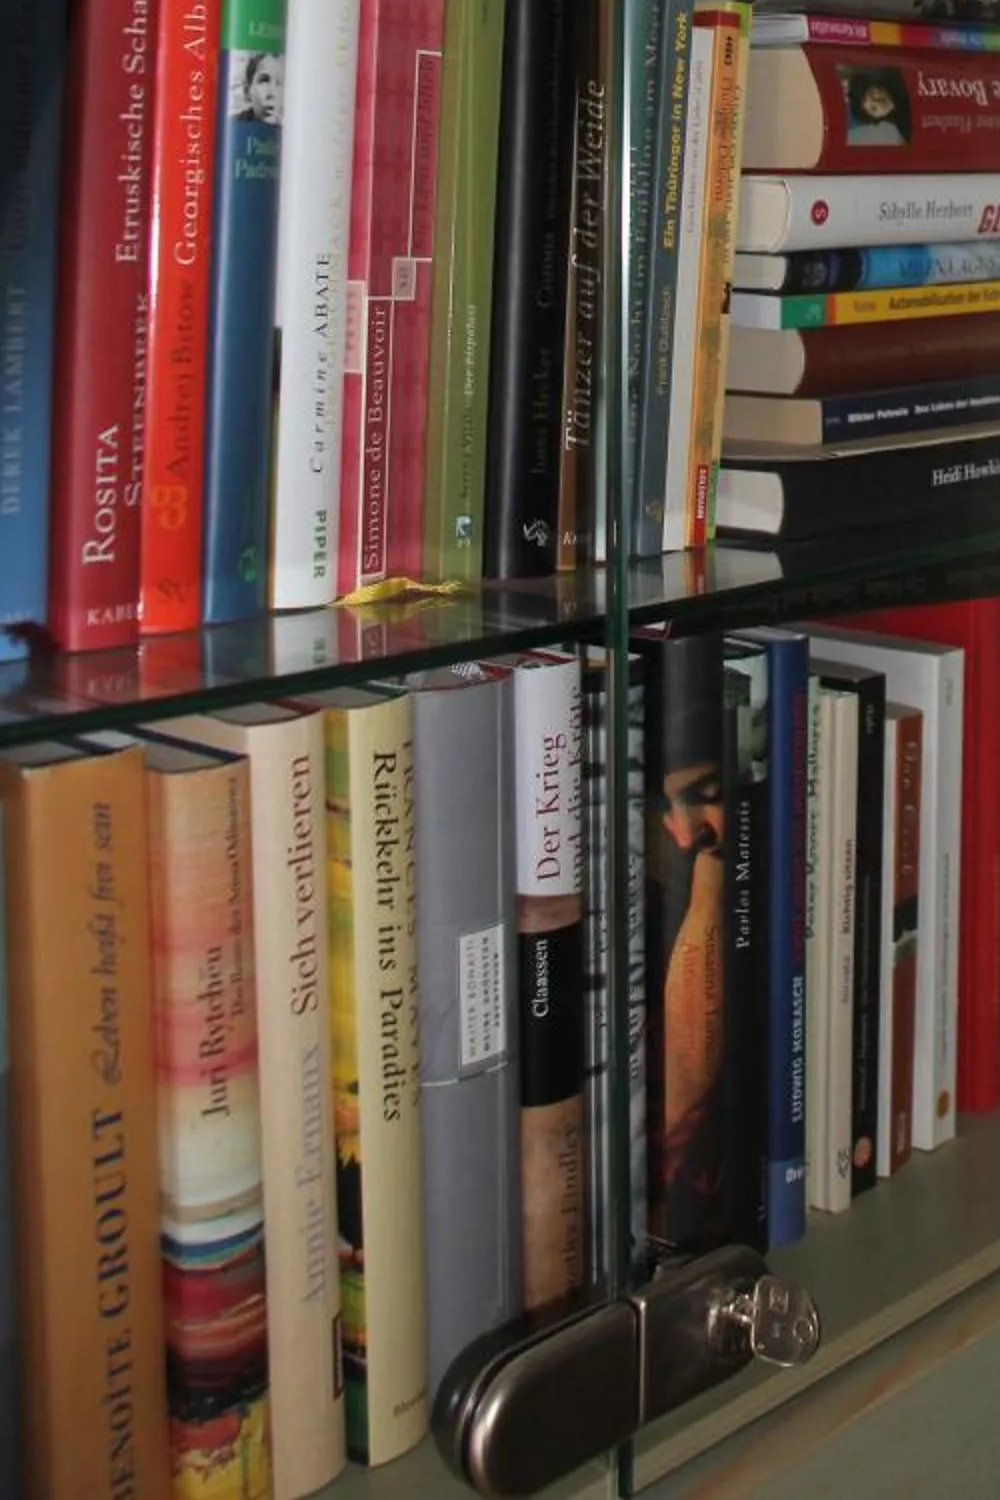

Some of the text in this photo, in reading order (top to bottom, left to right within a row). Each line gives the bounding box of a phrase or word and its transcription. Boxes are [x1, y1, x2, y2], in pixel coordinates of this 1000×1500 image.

[670, 57, 686, 98] New
[673, 10, 689, 52] York
[916, 70, 990, 107] Bovary
[112, 83, 146, 264] Etruskische
[172, 68, 206, 266] Georgisches
[663, 124, 682, 213] Thüringer
[564, 79, 606, 452] Tänzer auf der Weide
[662, 218, 677, 249] Ein
[165, 371, 195, 476] Andrej
[308, 253, 331, 475] Carmine ABATE
[80, 422, 120, 566] ROSITA
[364, 305, 387, 570] Simone de Beauvoir
[930, 466, 962, 489] Heidi
[287, 755, 317, 928] verlieren
[534, 732, 567, 882] Der Krieg
[289, 933, 320, 1016] Sich
[373, 752, 407, 1124] Rückkehr ins Paradies
[530, 938, 552, 1018] Claassen
[199, 1063, 230, 1117] Juri
[91, 1107, 130, 1318] GROULT
